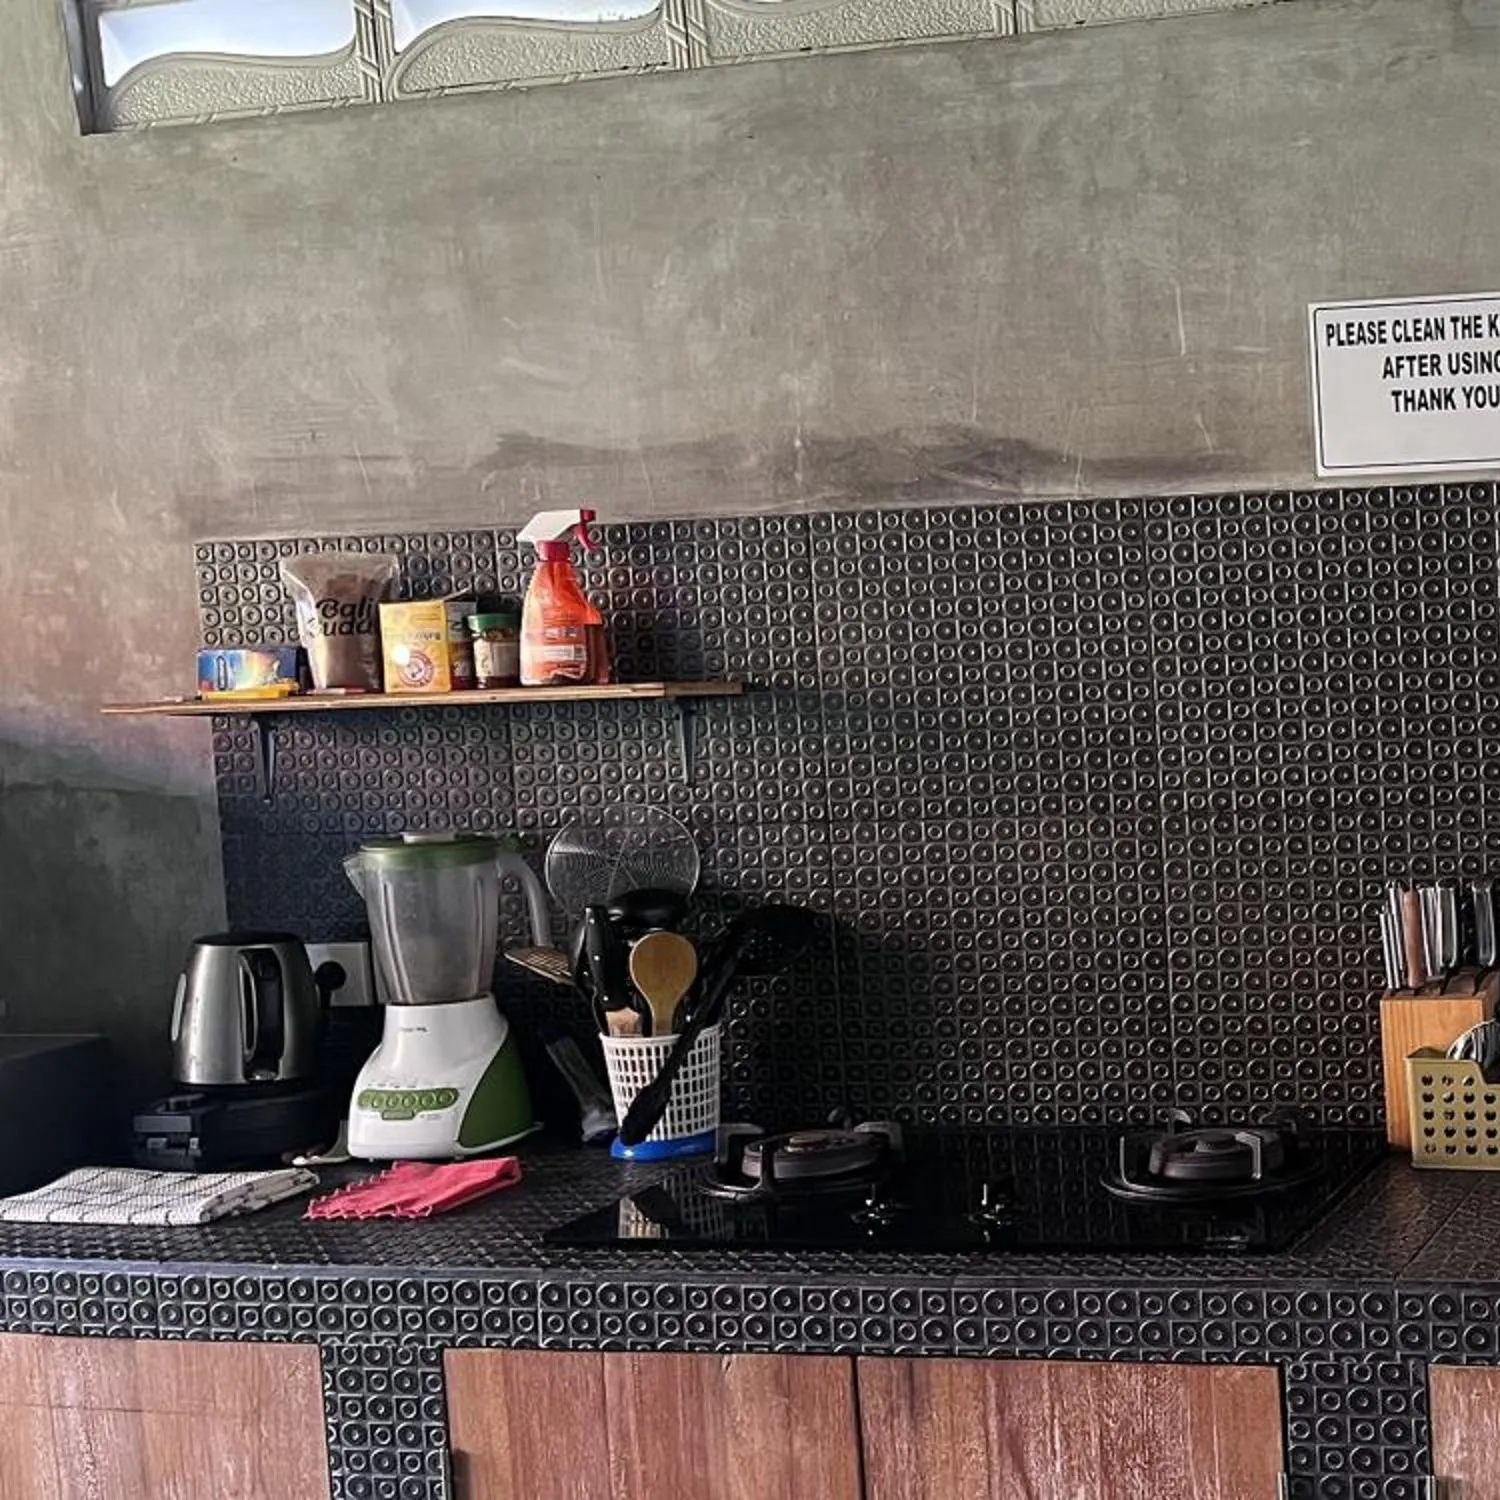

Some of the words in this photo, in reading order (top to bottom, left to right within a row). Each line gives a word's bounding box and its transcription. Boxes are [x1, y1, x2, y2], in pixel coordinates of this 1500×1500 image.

[1326, 320, 1388, 347] PLEASE
[1392, 316, 1446, 343] CLEAN
[1450, 314, 1484, 340] THE
[1382, 353, 1443, 380] AFTER
[1391, 387, 1457, 413] THANK
[1462, 385, 1500, 409] YOU
[315, 595, 375, 620] Bali
